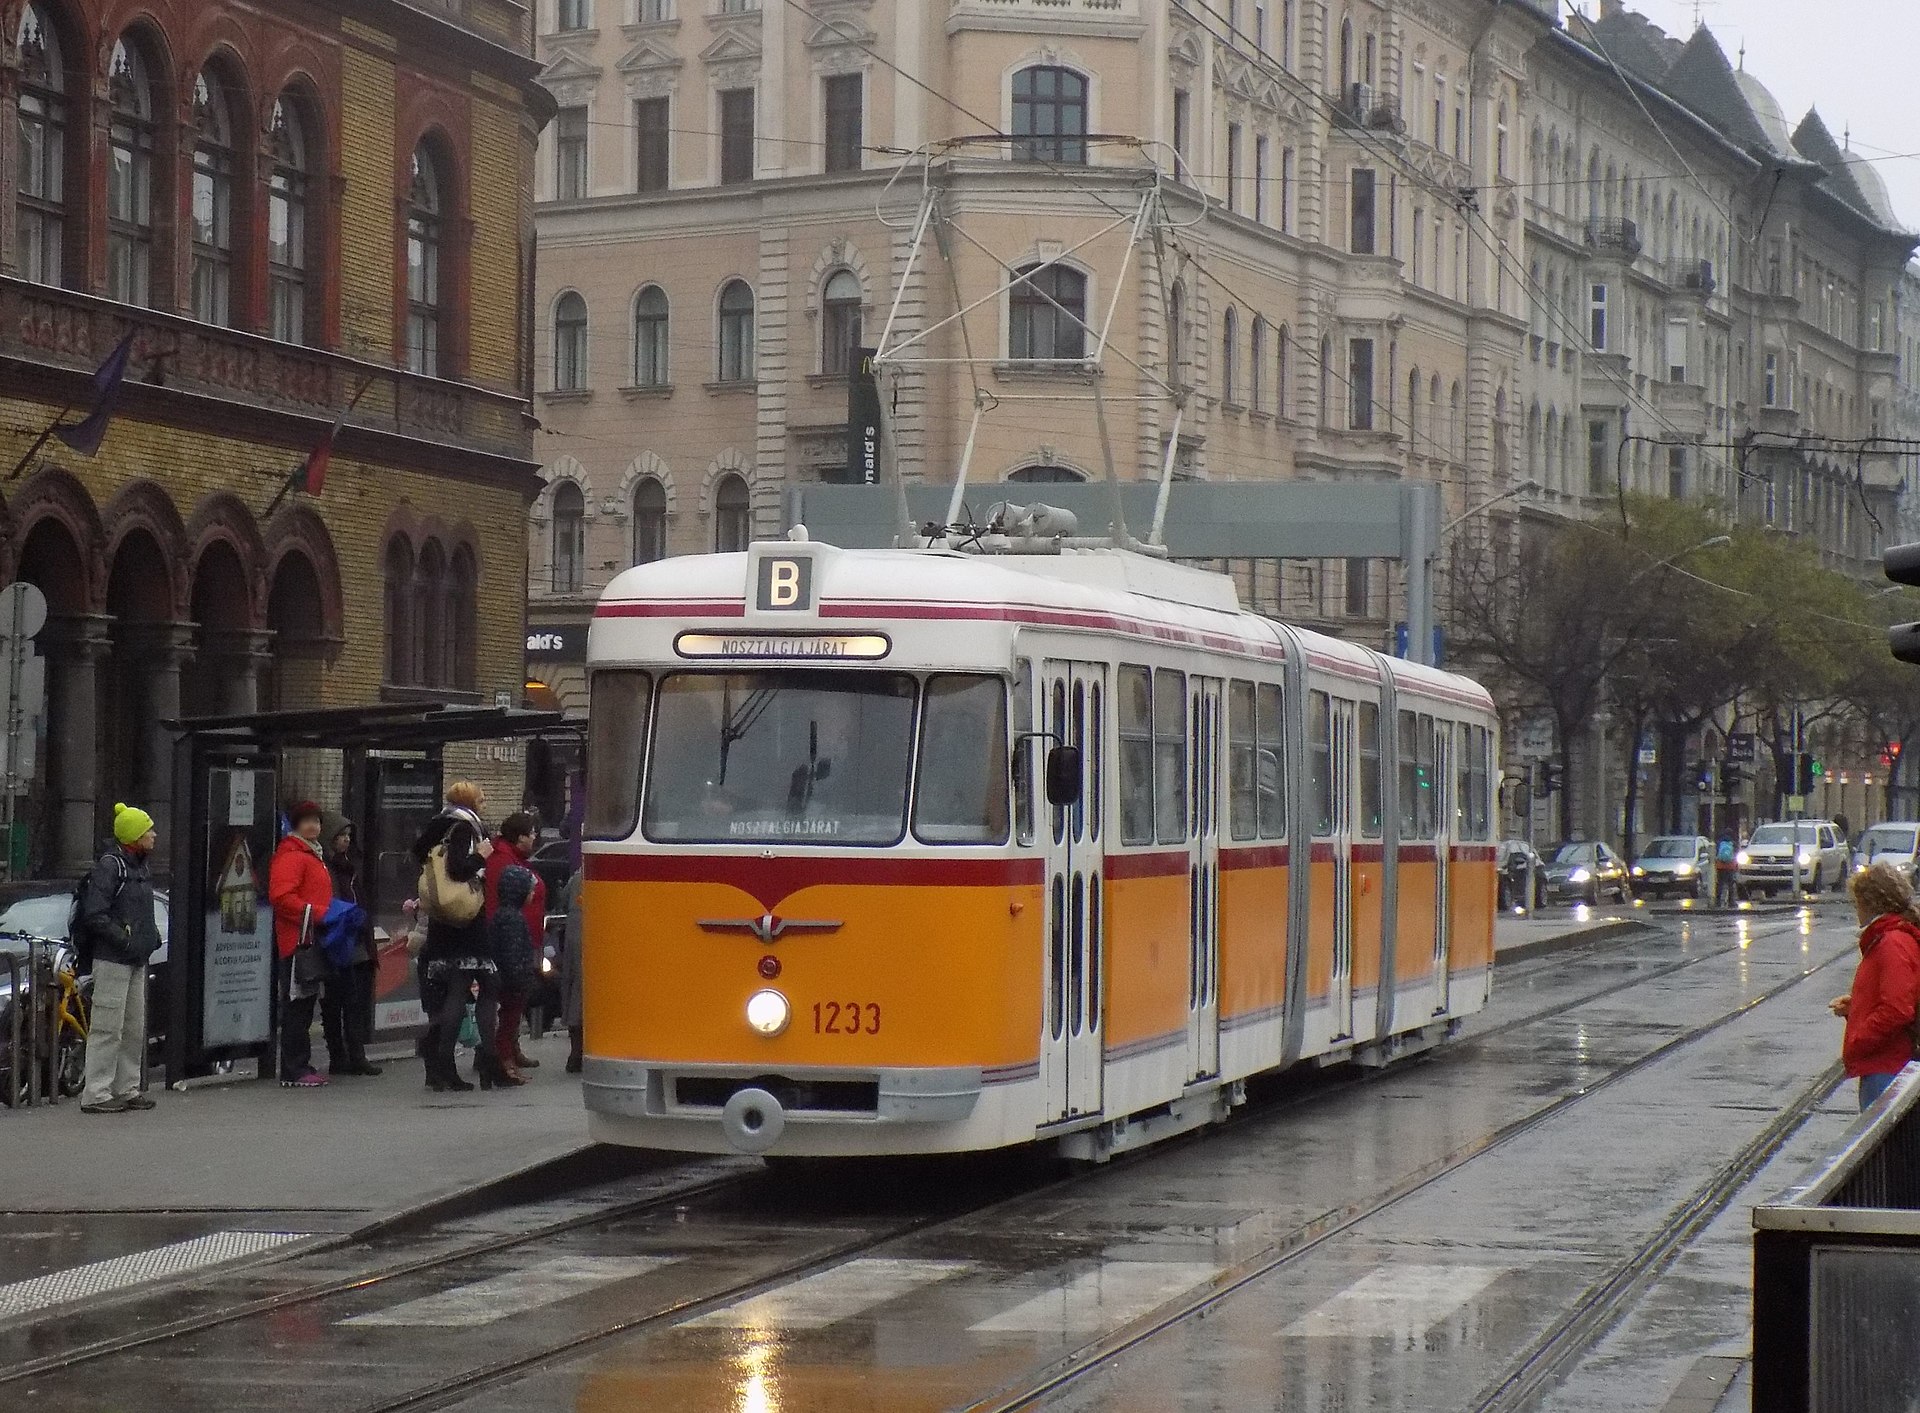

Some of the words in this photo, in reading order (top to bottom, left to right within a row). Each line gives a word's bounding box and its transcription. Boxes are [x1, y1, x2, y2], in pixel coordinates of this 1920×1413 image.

[864, 426, 875, 485] nald's
[770, 560, 799, 606] B
[721, 638, 848, 655] NOSZTALGIAJÁRAT
[813, 1001, 881, 1034] 1233
